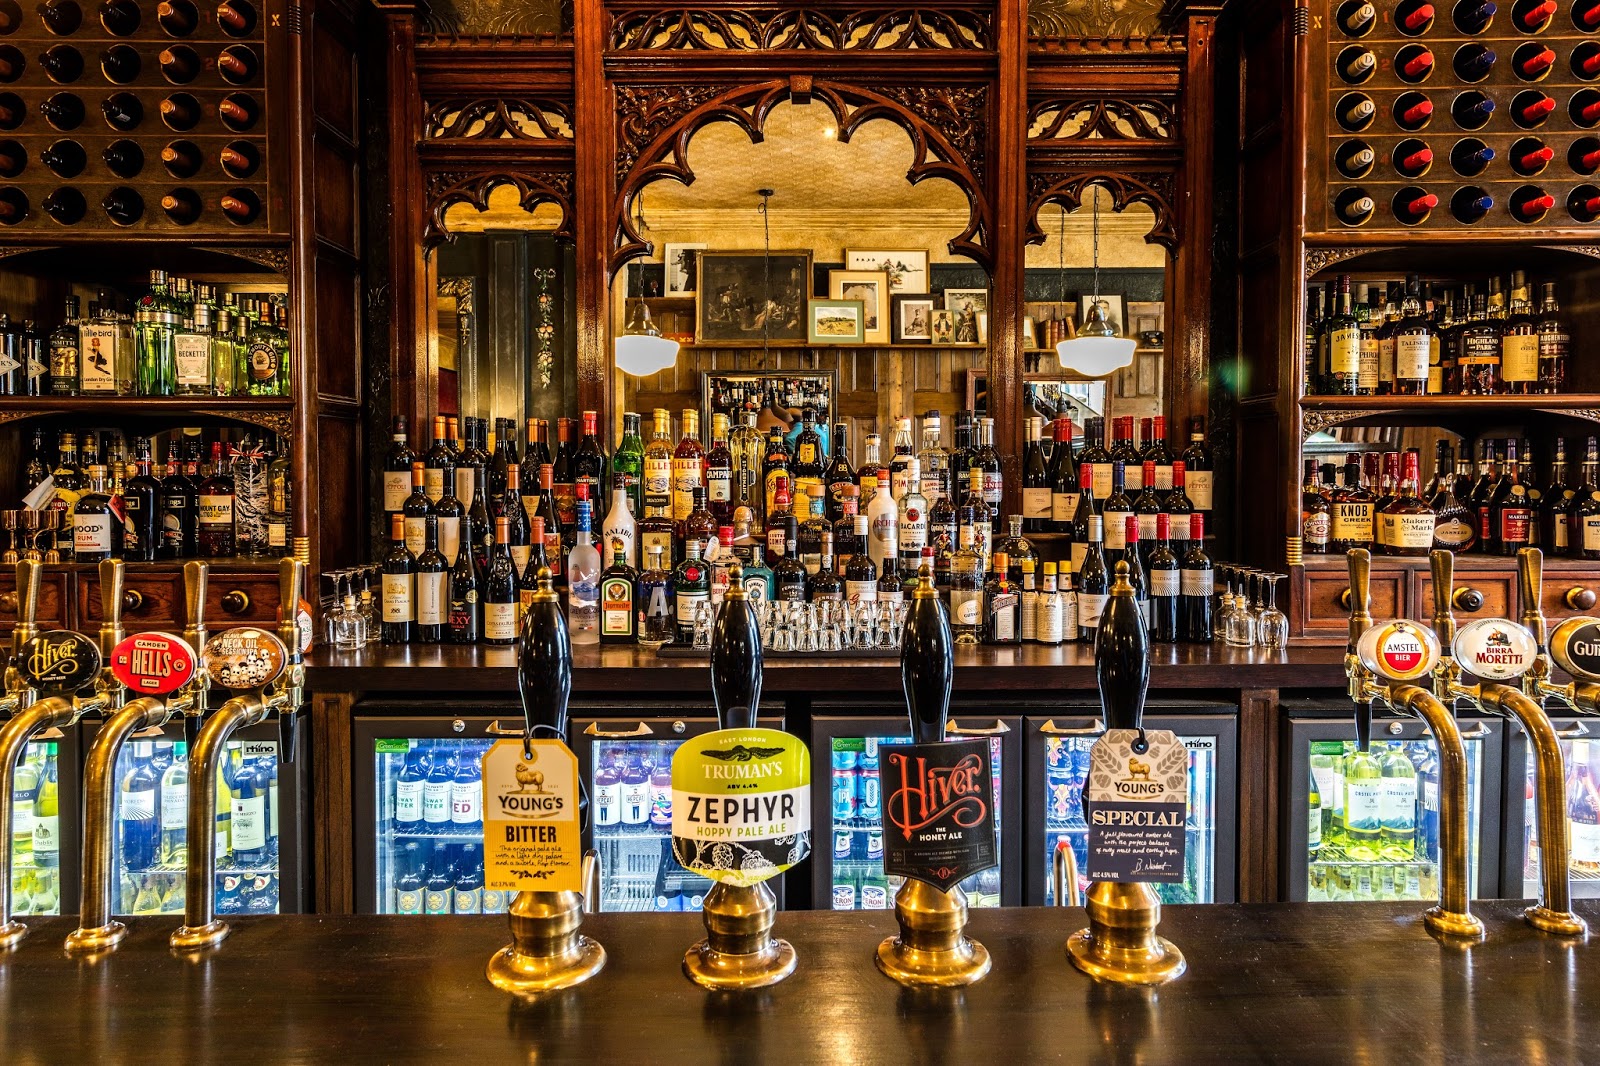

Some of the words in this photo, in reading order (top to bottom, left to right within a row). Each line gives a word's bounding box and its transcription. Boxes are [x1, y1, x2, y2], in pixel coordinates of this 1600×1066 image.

[98, 329, 112, 337] bird
[178, 350, 206, 358] BECKETTS
[706, 470, 732, 478] CAMPARI
[1340, 505, 1368, 516] KNOB
[604, 528, 633, 539] MALIBU
[222, 638, 243, 648] NECK
[245, 638, 258, 648] OIL
[1387, 644, 1419, 652] AMSTEL
[132, 649, 172, 677] HELLS
[1476, 652, 1522, 664] MORETTI
[246, 743, 274, 753] rhino
[1185, 738, 1212, 748] rhino
[702, 761, 783, 780] TRUMAN'S
[1114, 782, 1164, 794] YOUNG'S
[498, 795, 564, 810] YOUNG'S
[688, 794, 794, 824] ZEPHYR
[1092, 809, 1184, 827] SPECIAL
[506, 825, 557, 843] BITTER
[697, 826, 732, 838] HOPPY
[738, 826, 764, 837] PALE
[769, 823, 786, 834] ALE
[920, 833, 946, 842] HONEY
[948, 832, 962, 840] ALE
[512, 845, 536, 854] original
[538, 844, 550, 854] pale
